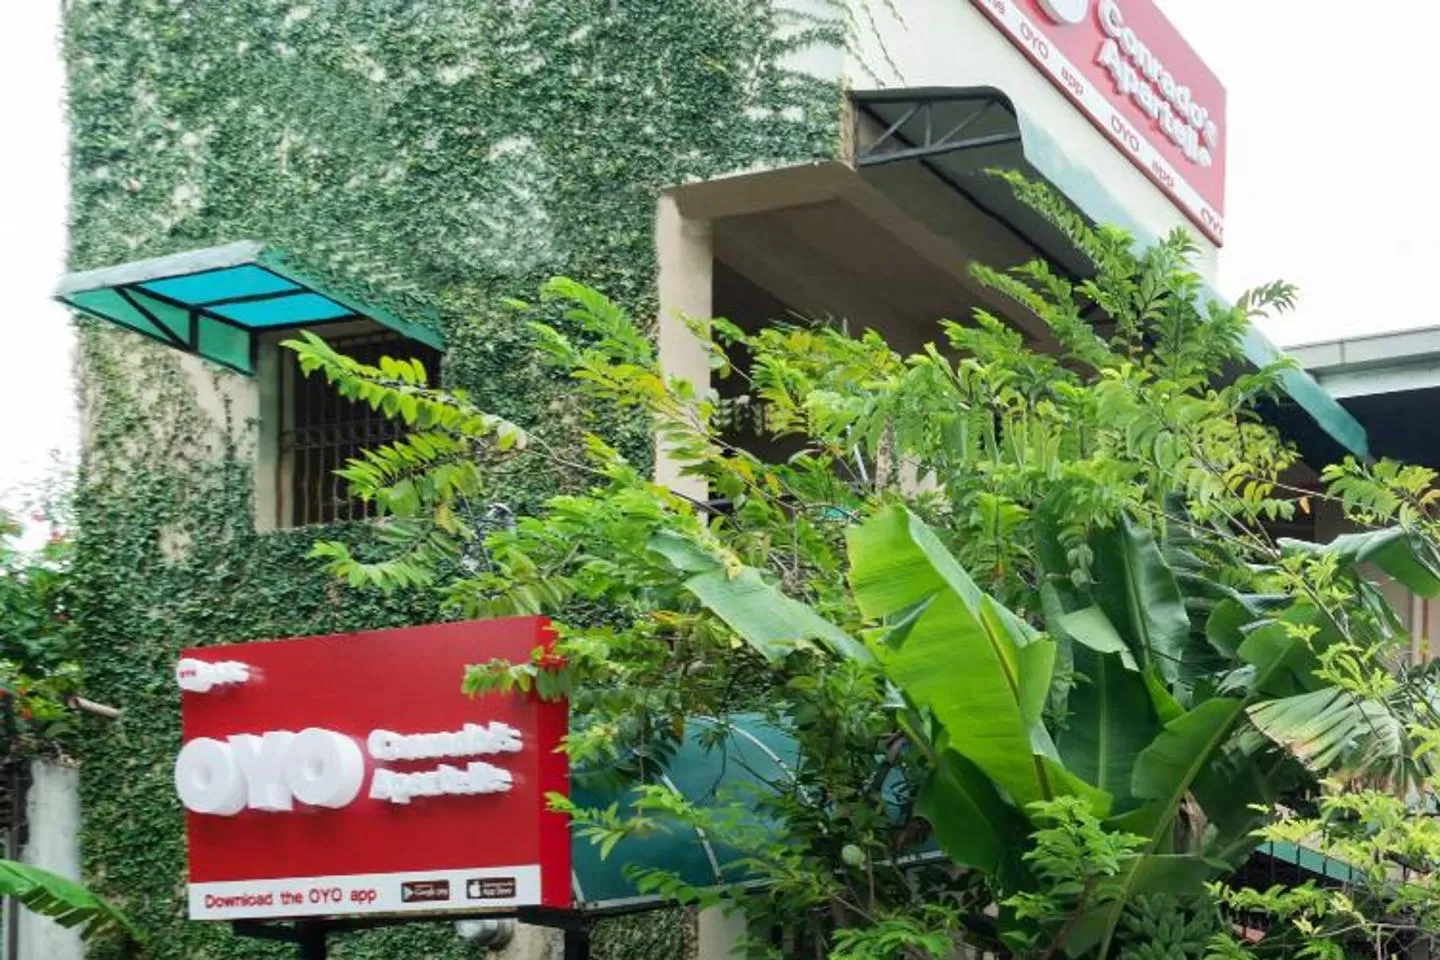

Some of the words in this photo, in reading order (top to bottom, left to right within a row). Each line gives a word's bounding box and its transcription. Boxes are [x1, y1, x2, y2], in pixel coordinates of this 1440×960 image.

[174, 727, 365, 816] OYO
[204, 894, 273, 909] Download
[279, 890, 304, 905] the
[308, 887, 343, 904] OYO
[350, 889, 377, 904] app
